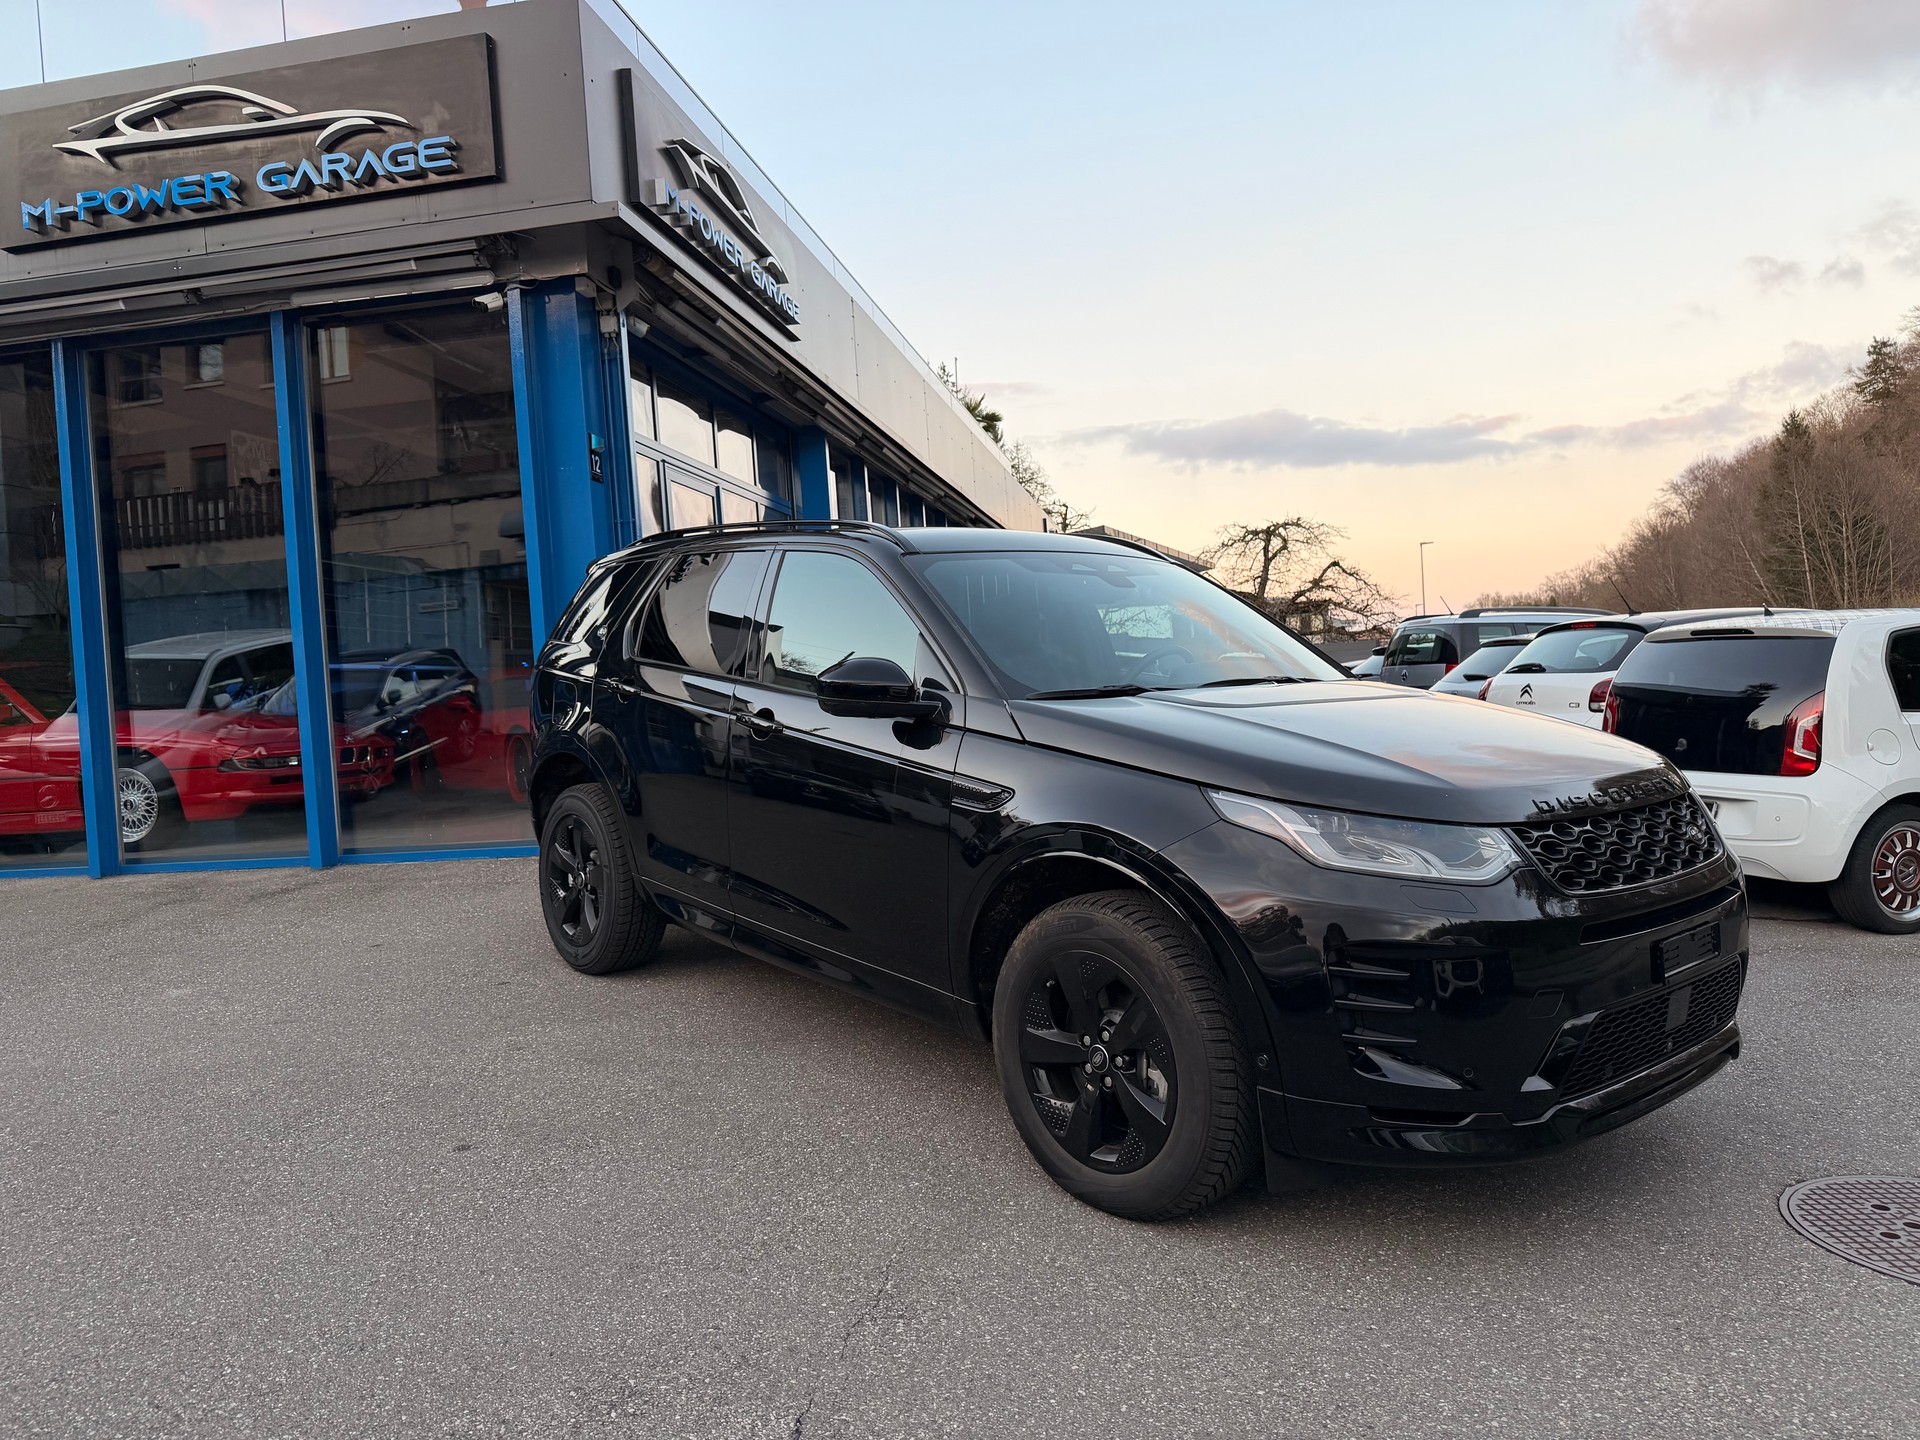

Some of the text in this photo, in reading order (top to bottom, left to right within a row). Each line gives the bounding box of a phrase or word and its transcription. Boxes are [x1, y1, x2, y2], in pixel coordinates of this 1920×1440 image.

[21, 136, 455, 230] M-POWER GARAGE
[664, 180, 800, 319] M-POWER GARAGE
[591, 454, 601, 473] 12
